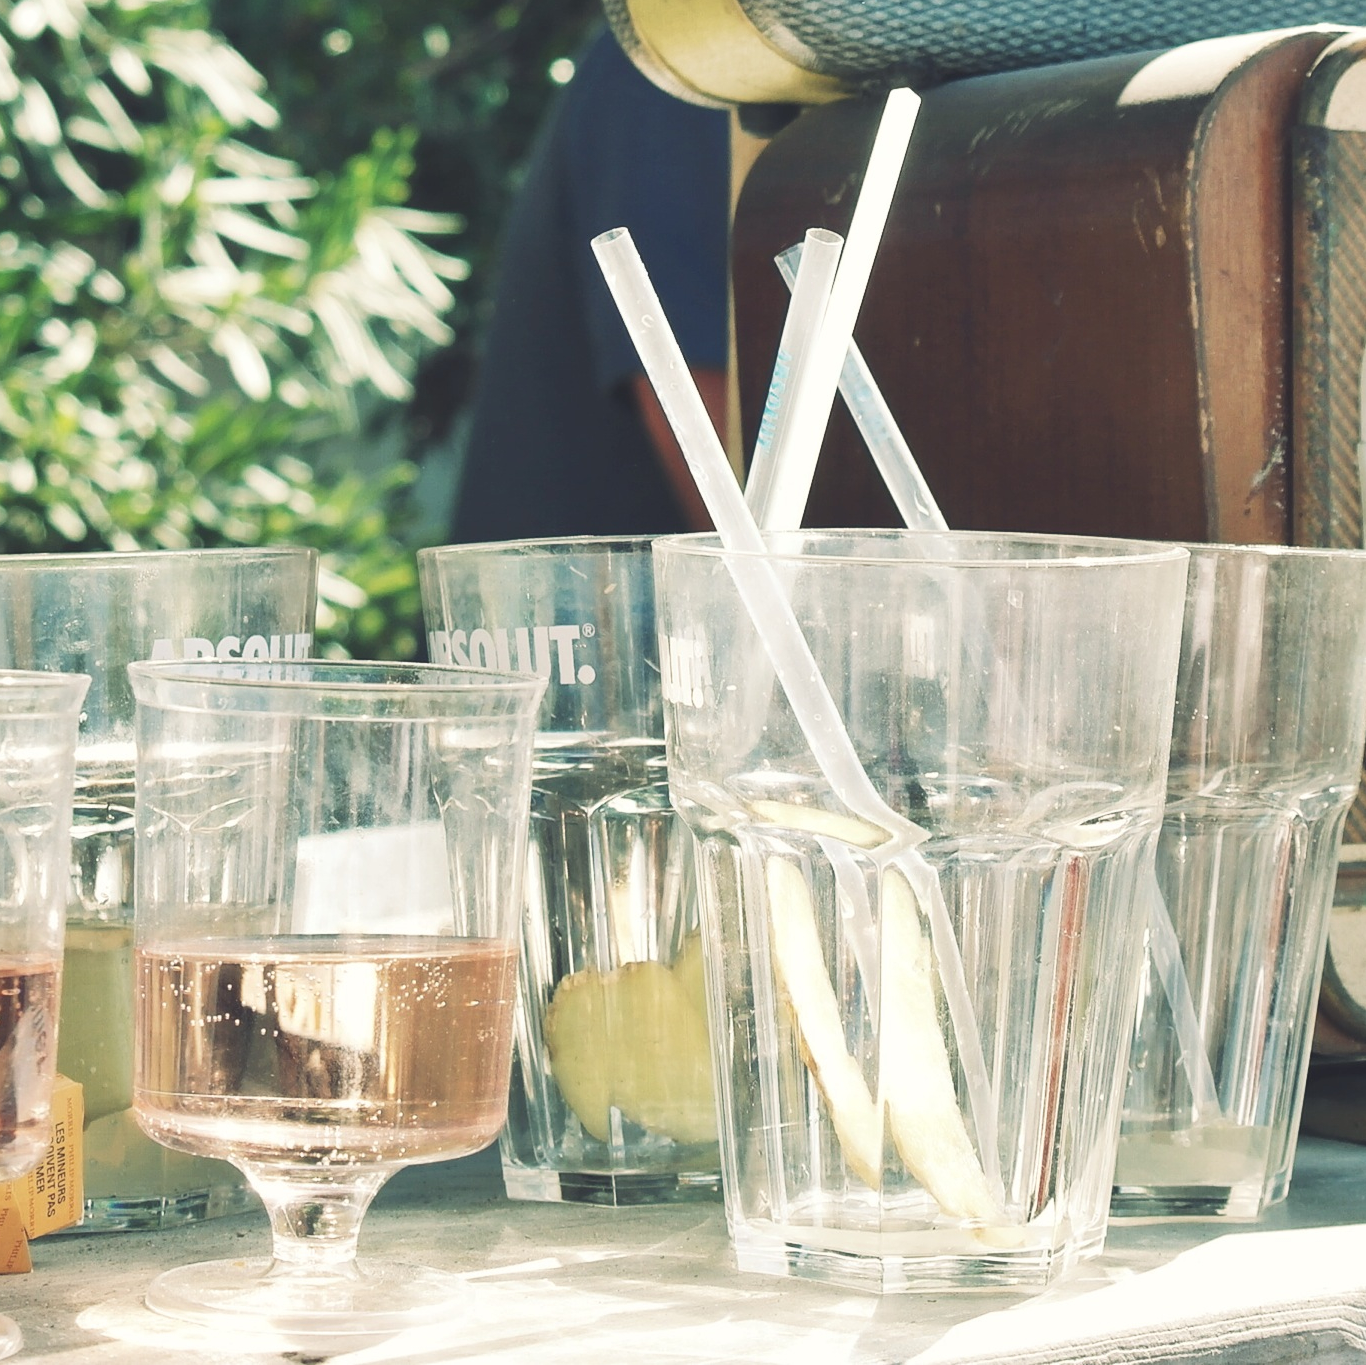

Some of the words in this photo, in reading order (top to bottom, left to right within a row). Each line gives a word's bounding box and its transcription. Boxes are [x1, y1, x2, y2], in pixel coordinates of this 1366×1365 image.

[55, 1122, 65, 1144] LES
[35, 1161, 46, 1195] MER
[56, 1147, 66, 1205] MINEURS
[47, 1192, 56, 1218] PAS
